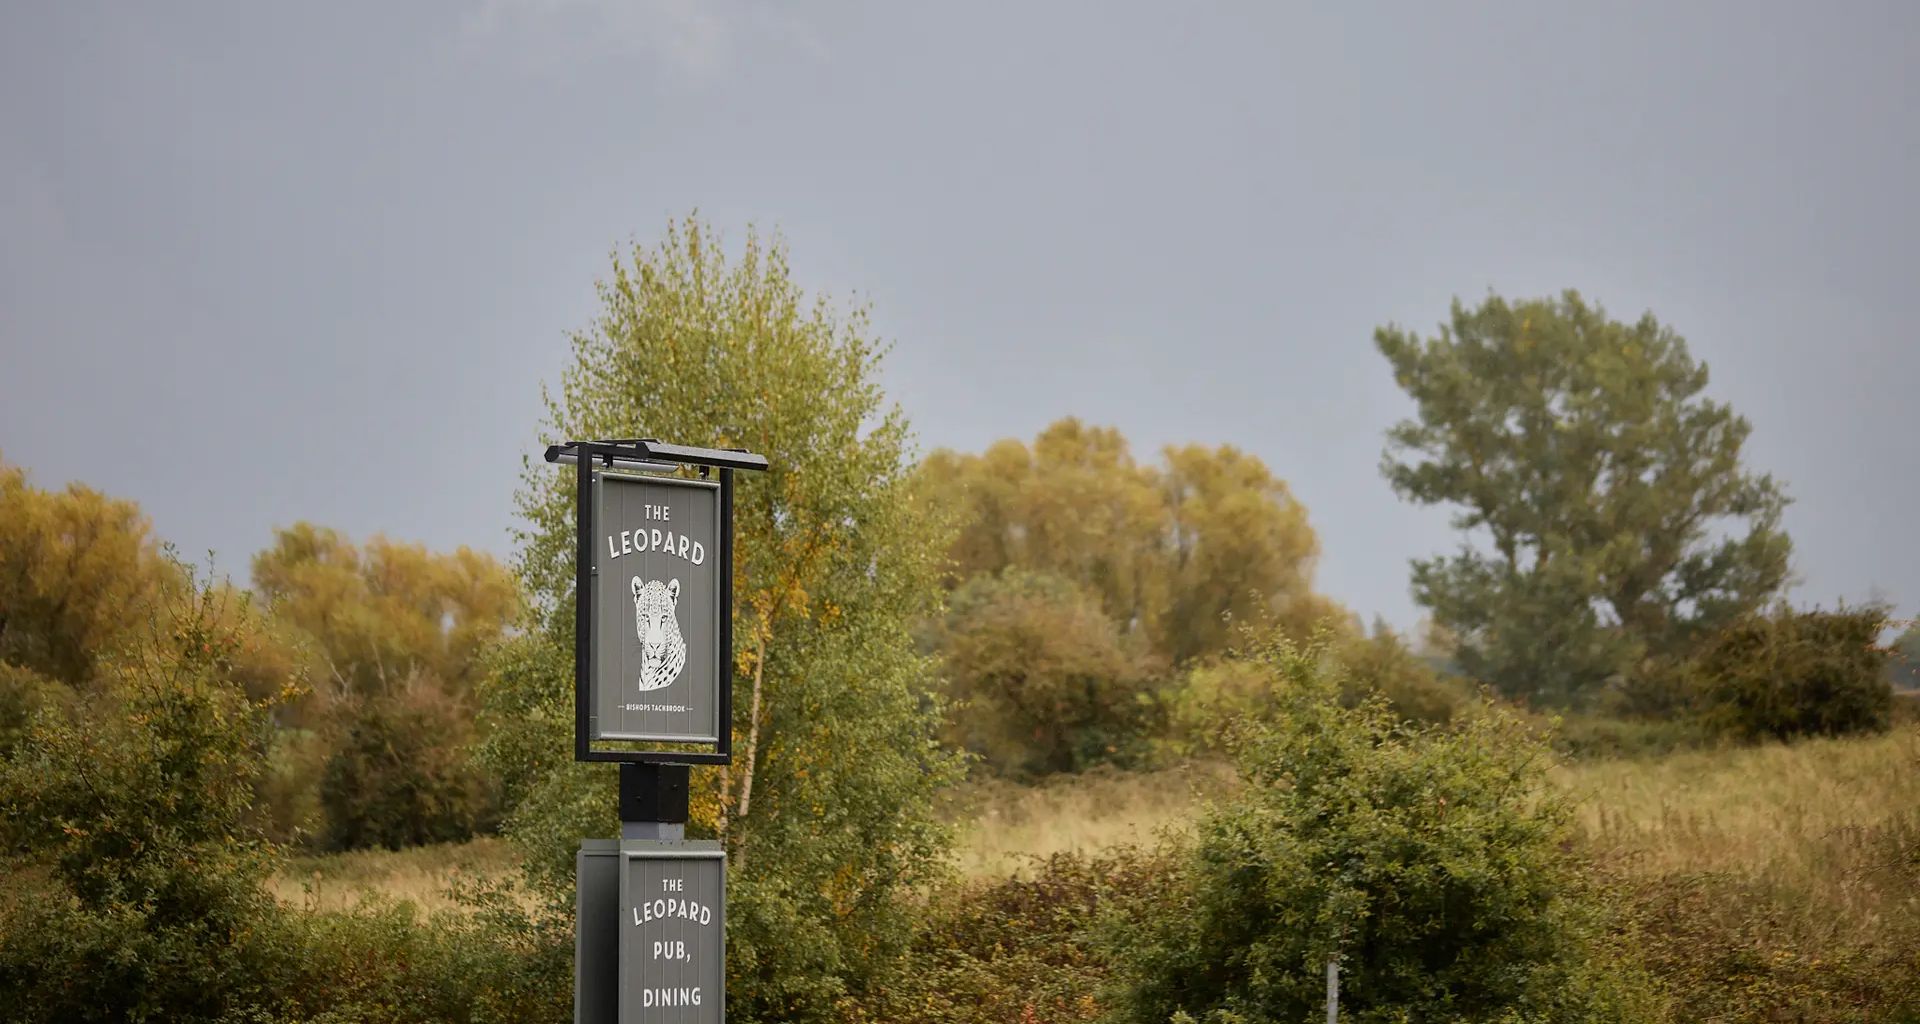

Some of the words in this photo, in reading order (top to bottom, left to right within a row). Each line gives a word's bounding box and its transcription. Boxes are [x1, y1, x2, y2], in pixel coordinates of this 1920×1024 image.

[644, 504, 670, 521] THE
[607, 528, 705, 565] LEOPARD
[625, 703, 651, 712] BISHOPS
[651, 704, 686, 713] TACHBROOK
[662, 878, 683, 892] THE
[633, 898, 711, 926] LEOPARD
[653, 940, 691, 963] PUB,
[643, 986, 701, 1008] DINING
